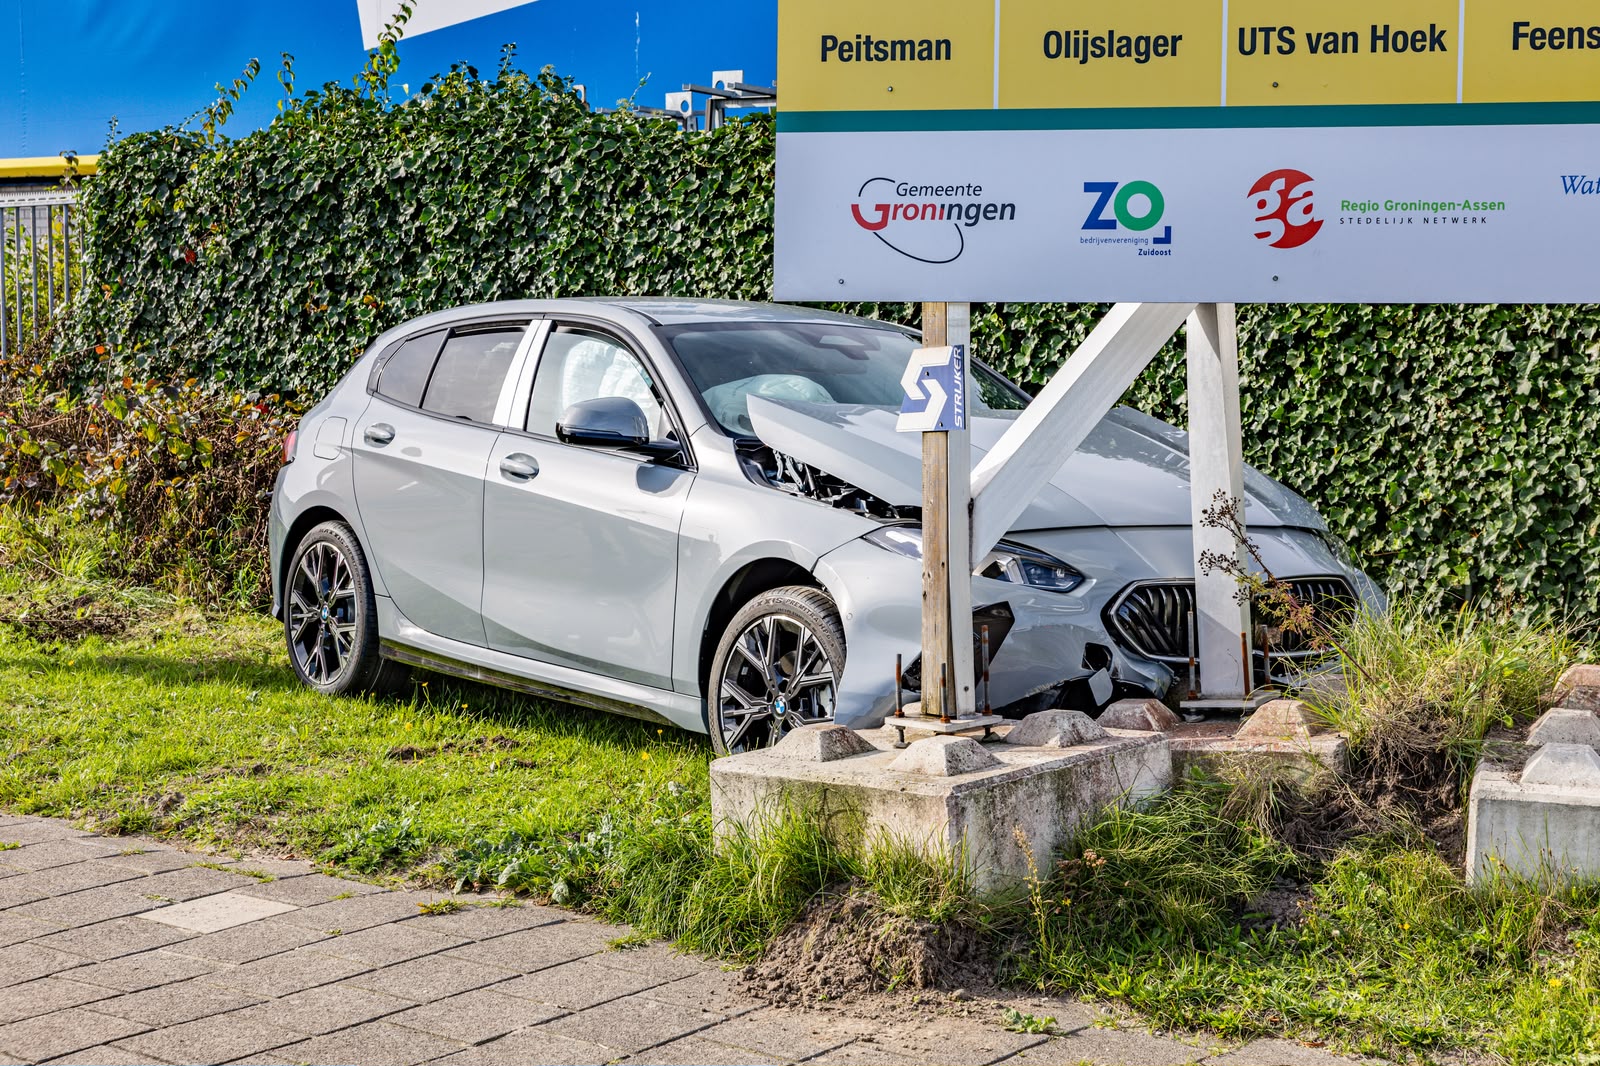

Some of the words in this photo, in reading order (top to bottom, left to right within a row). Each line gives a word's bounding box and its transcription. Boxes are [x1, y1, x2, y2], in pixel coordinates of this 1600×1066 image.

[820, 33, 952, 63] Peitsman
[1043, 29, 1183, 65] Olijslager
[1238, 26, 1296, 56] UTS
[1305, 31, 1359, 55] van
[1370, 23, 1448, 54] Hoek
[1512, 21, 1600, 51] Feens
[896, 181, 983, 197] Gemeente
[850, 202, 1016, 231] Groningen
[1081, 180, 1165, 231] ZO
[1341, 199, 1380, 214] Regio
[1383, 199, 1506, 214] Groningen-Assen
[1339, 217, 1414, 225] STEDELIJK
[1423, 216, 1488, 224] NETWERK
[1079, 236, 1149, 246] bedrijvenvereniging
[1138, 248, 1172, 256] Zuidoost
